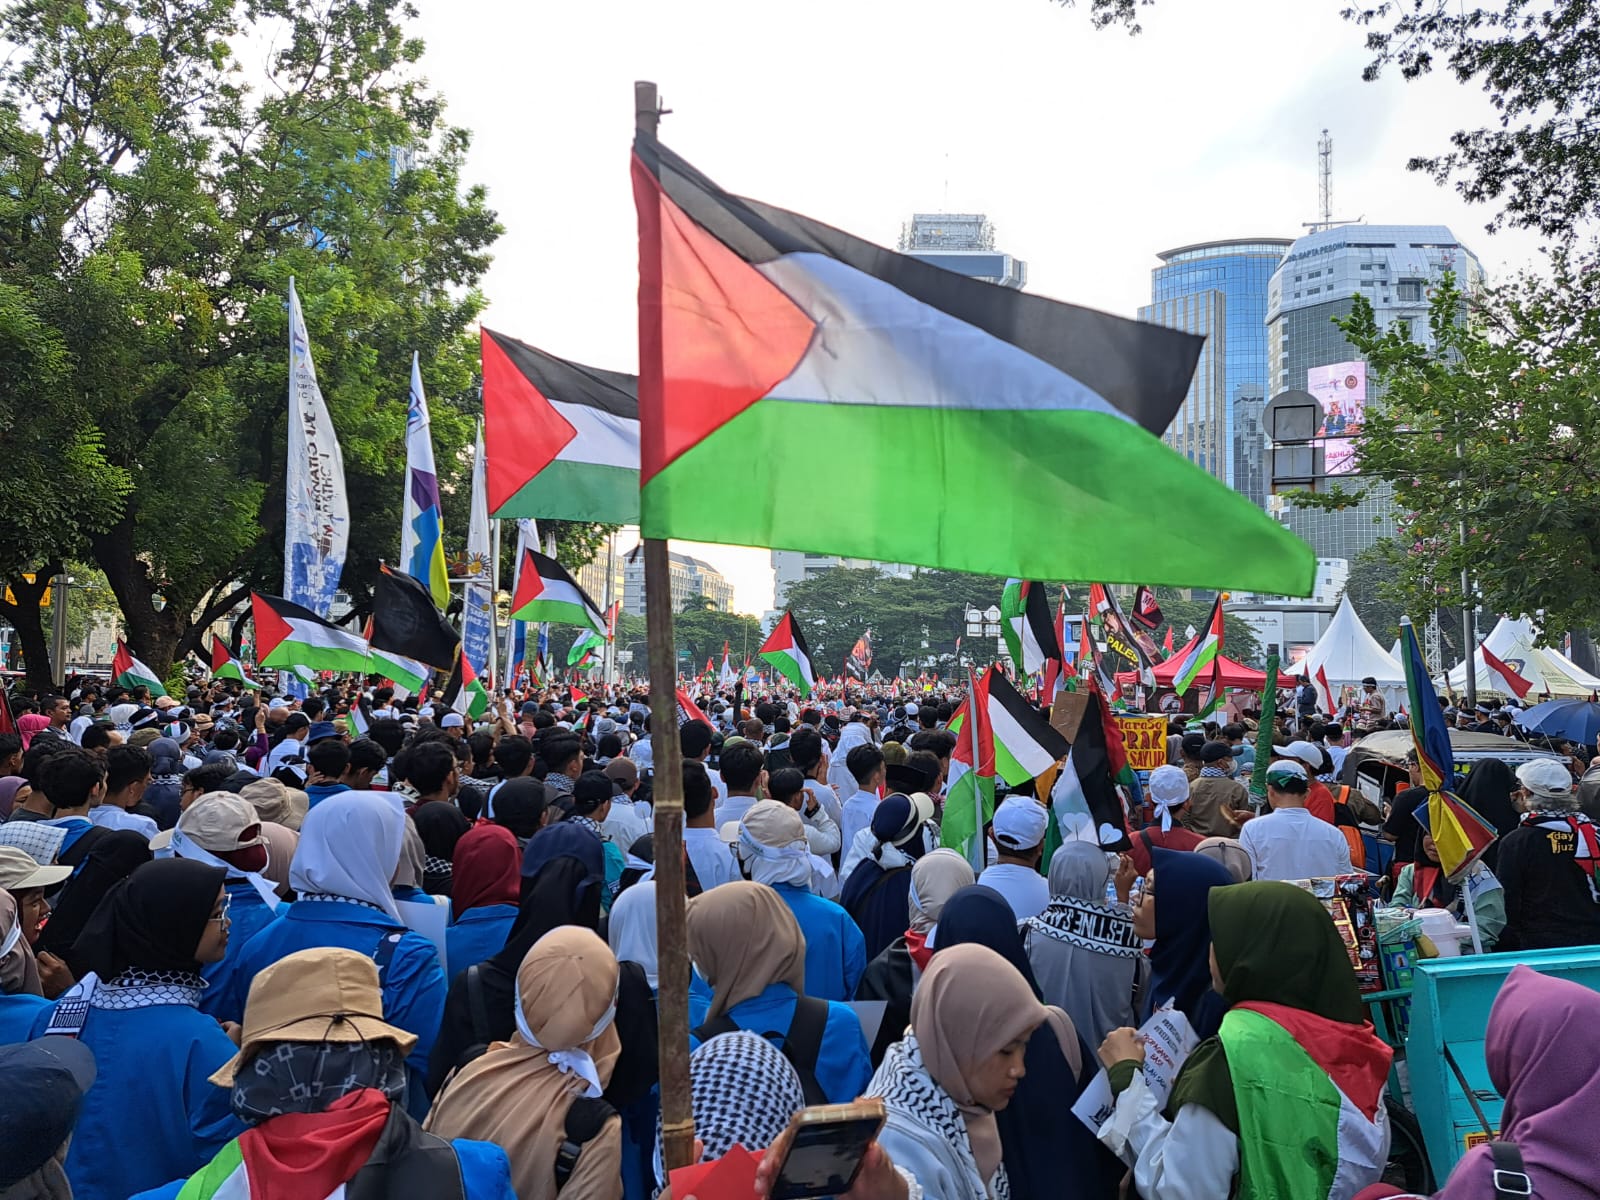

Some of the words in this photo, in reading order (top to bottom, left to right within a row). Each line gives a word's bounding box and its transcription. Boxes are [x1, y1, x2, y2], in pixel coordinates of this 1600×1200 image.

[1129, 750, 1165, 768] SAYUR
[1554, 831, 1574, 842] day
[1556, 842, 1574, 854] juz
[1073, 910, 1143, 947] ALESTINE
